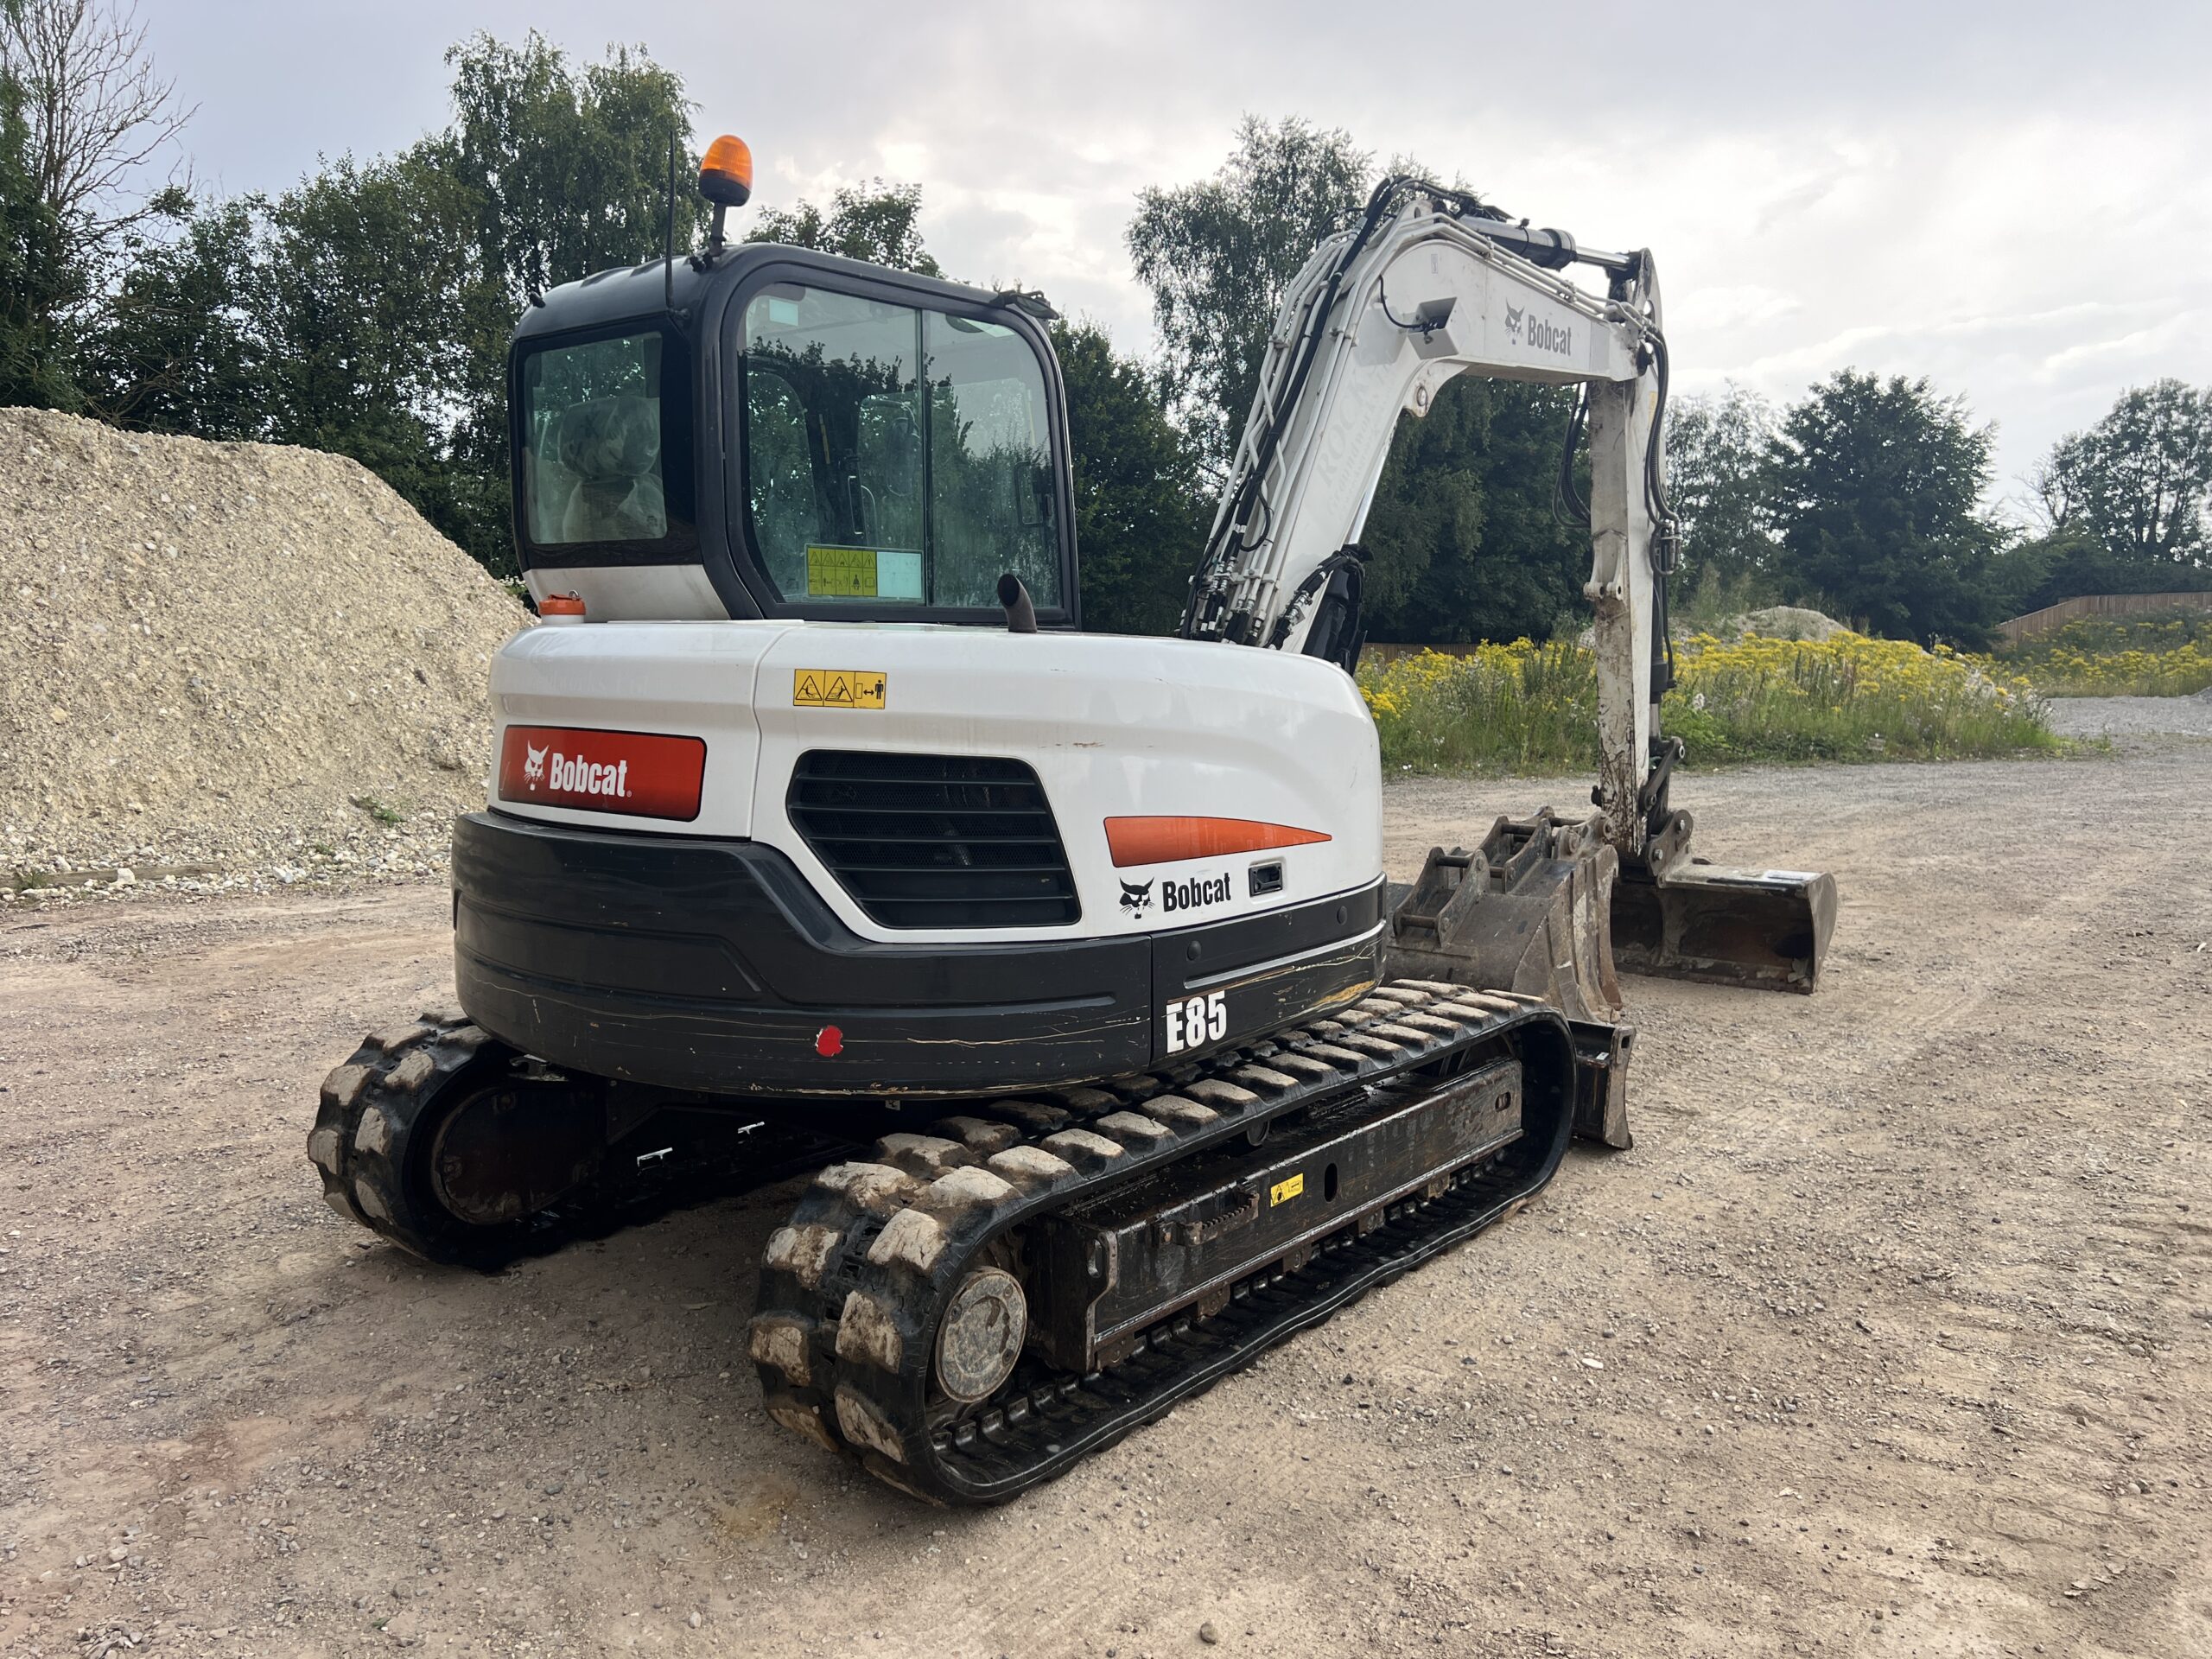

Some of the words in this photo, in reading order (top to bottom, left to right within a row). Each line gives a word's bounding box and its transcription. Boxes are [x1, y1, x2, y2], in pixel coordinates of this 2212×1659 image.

[1528, 314, 1572, 357] Bobcat
[550, 753, 628, 797] Bobcat
[1162, 873, 1230, 912] Bobcat
[1166, 989, 1227, 1053] E85
